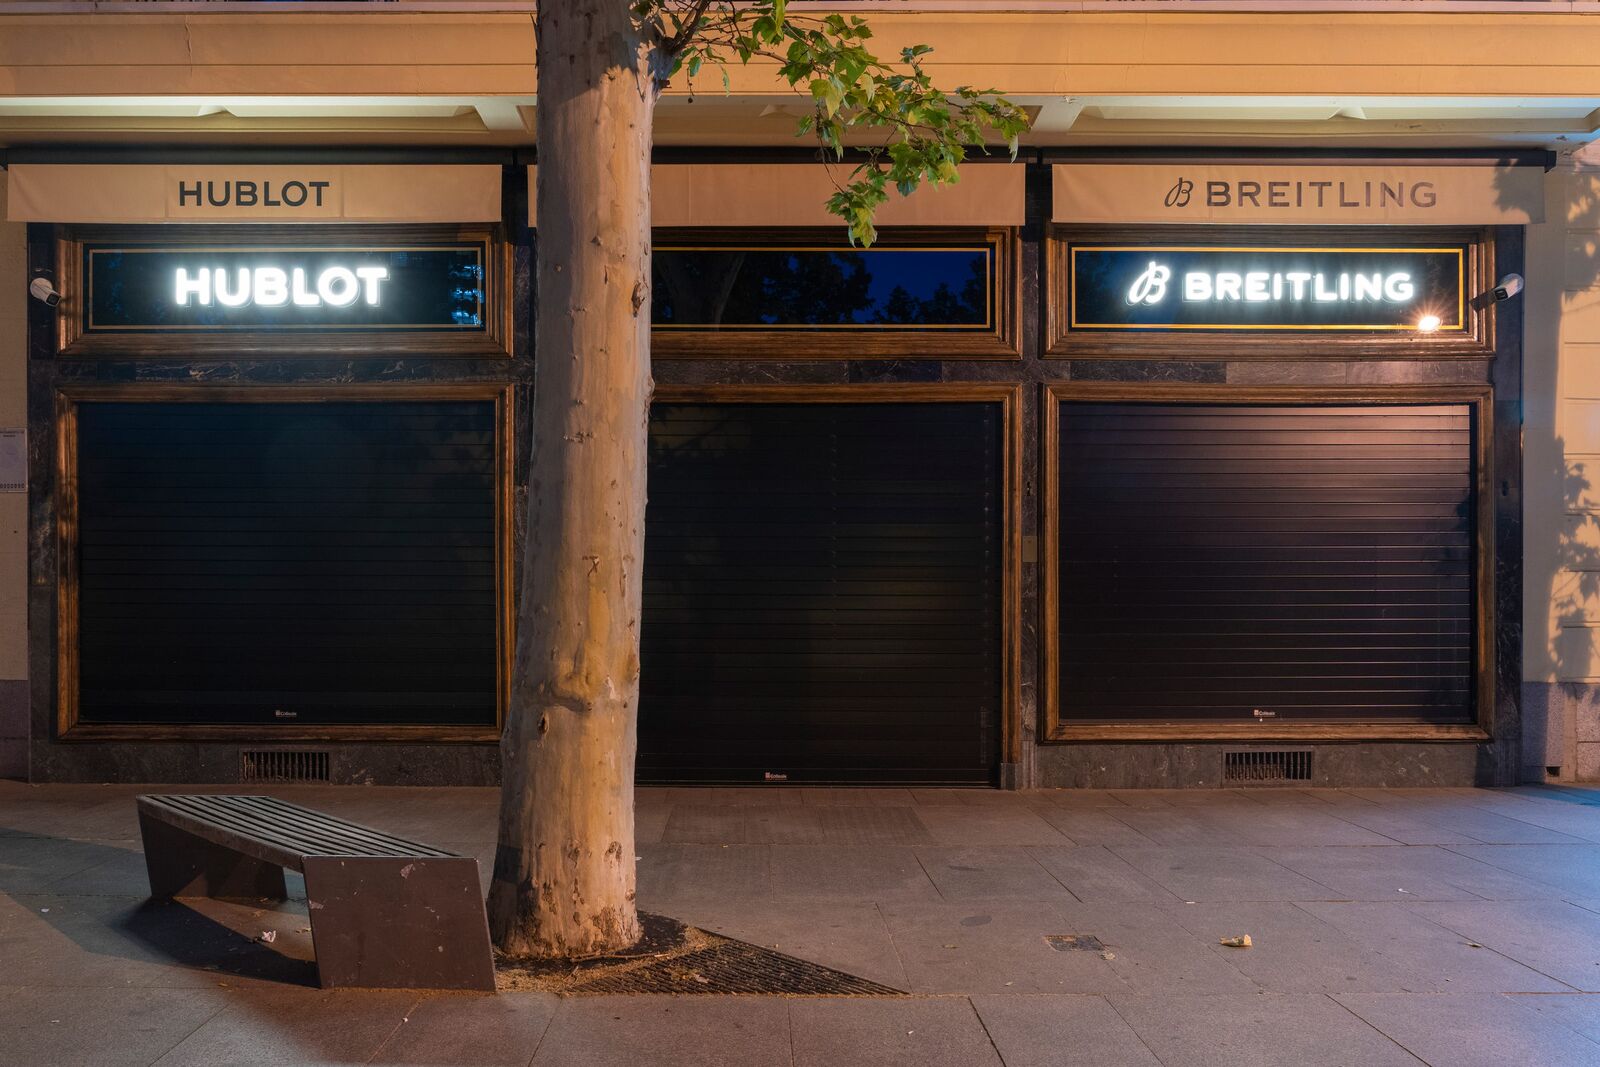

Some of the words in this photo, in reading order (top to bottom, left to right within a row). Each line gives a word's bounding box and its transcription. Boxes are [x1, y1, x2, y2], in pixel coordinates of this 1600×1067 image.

[178, 180, 330, 207] HUBLOT
[1206, 181, 1437, 208] BREITLING
[174, 266, 388, 308] HUBLOT
[1183, 270, 1416, 304] BREITLING
